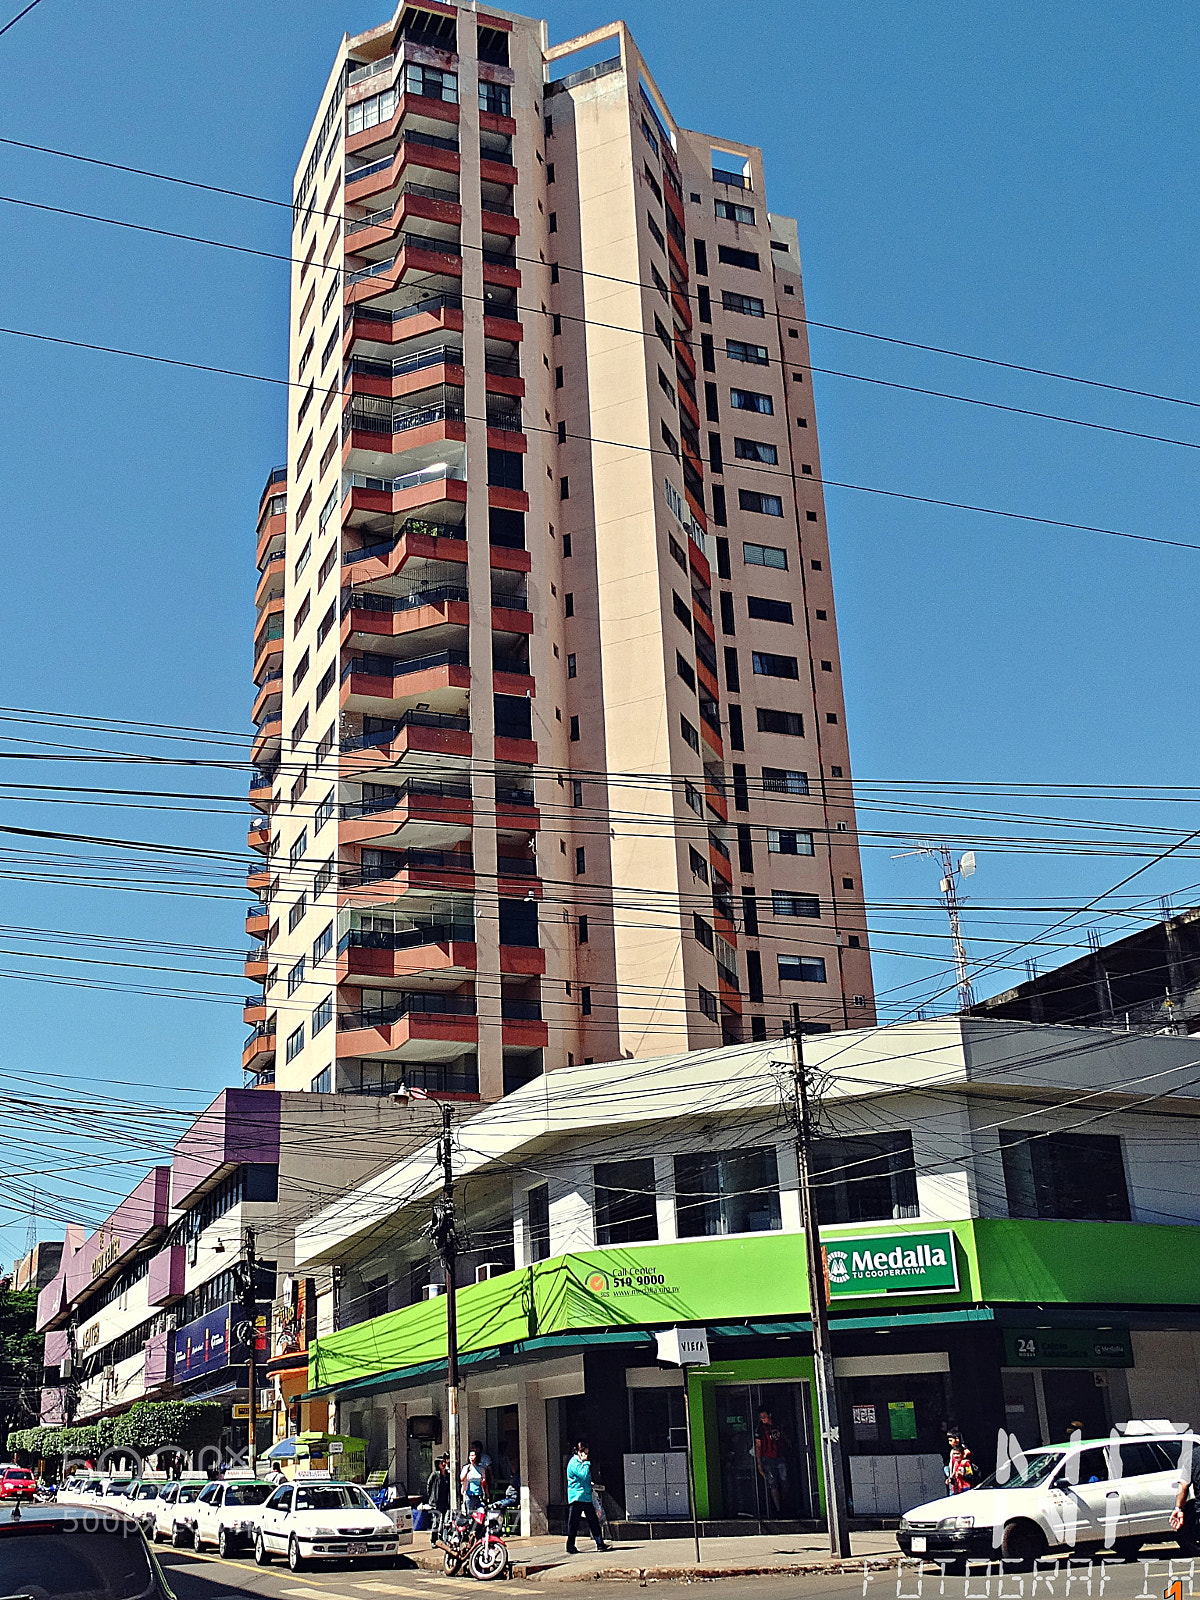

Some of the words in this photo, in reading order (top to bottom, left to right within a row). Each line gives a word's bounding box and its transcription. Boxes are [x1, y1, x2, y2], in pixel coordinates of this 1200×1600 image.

[852, 1245, 948, 1271] Medalla
[612, 1267, 627, 1277] Call
[630, 1266, 657, 1276] Center
[865, 1267, 926, 1278] COOPERATIVA
[637, 1274, 665, 1286] 9000
[1017, 1339, 1036, 1353] 24
